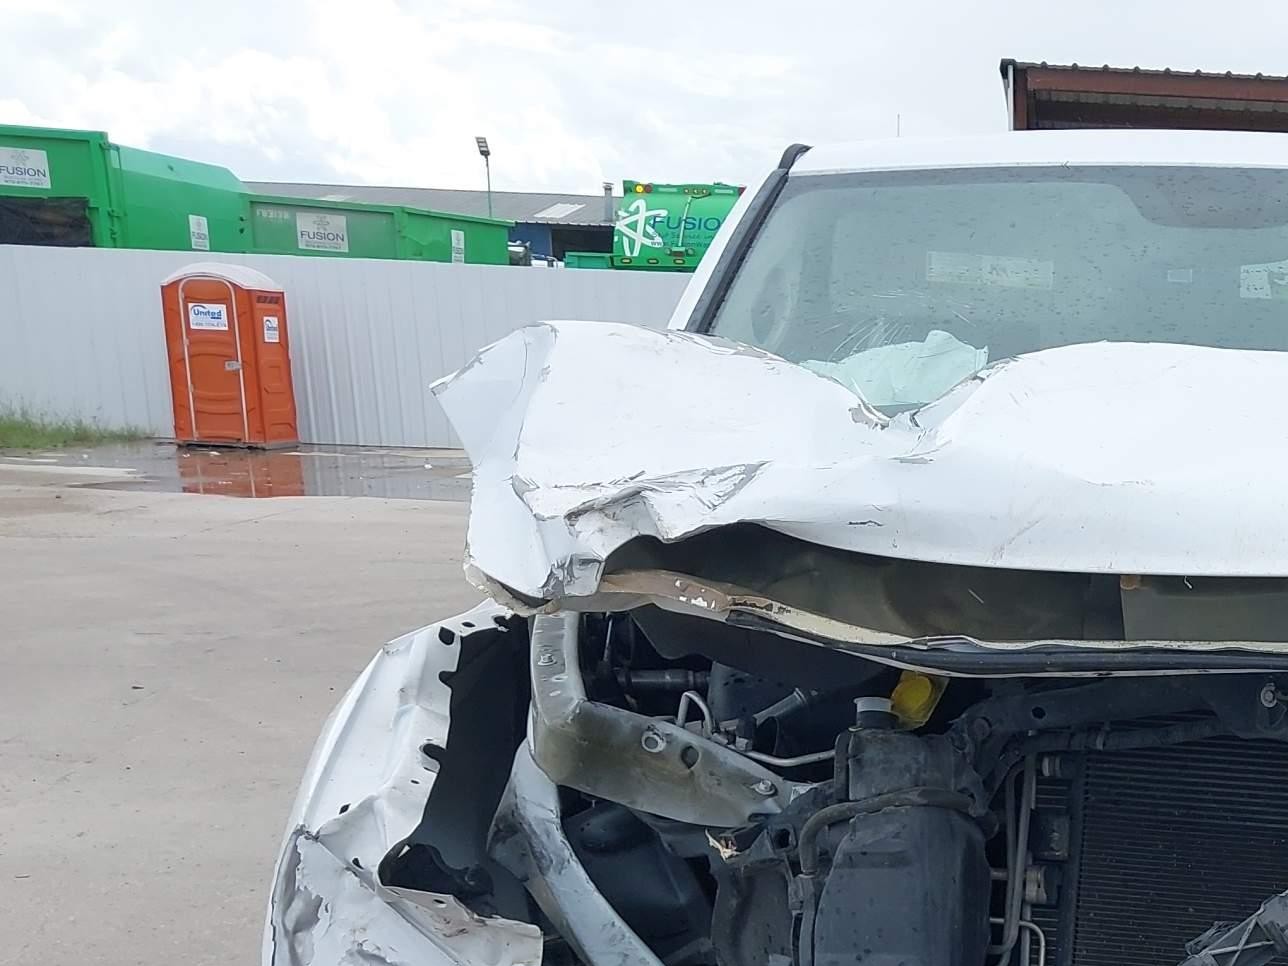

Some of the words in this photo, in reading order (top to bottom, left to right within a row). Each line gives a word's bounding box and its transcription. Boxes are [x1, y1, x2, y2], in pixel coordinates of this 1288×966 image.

[0, 165, 47, 178] FUSION
[652, 215, 721, 231] FUSIO
[300, 230, 345, 242] FUSION
[193, 308, 222, 317] United
